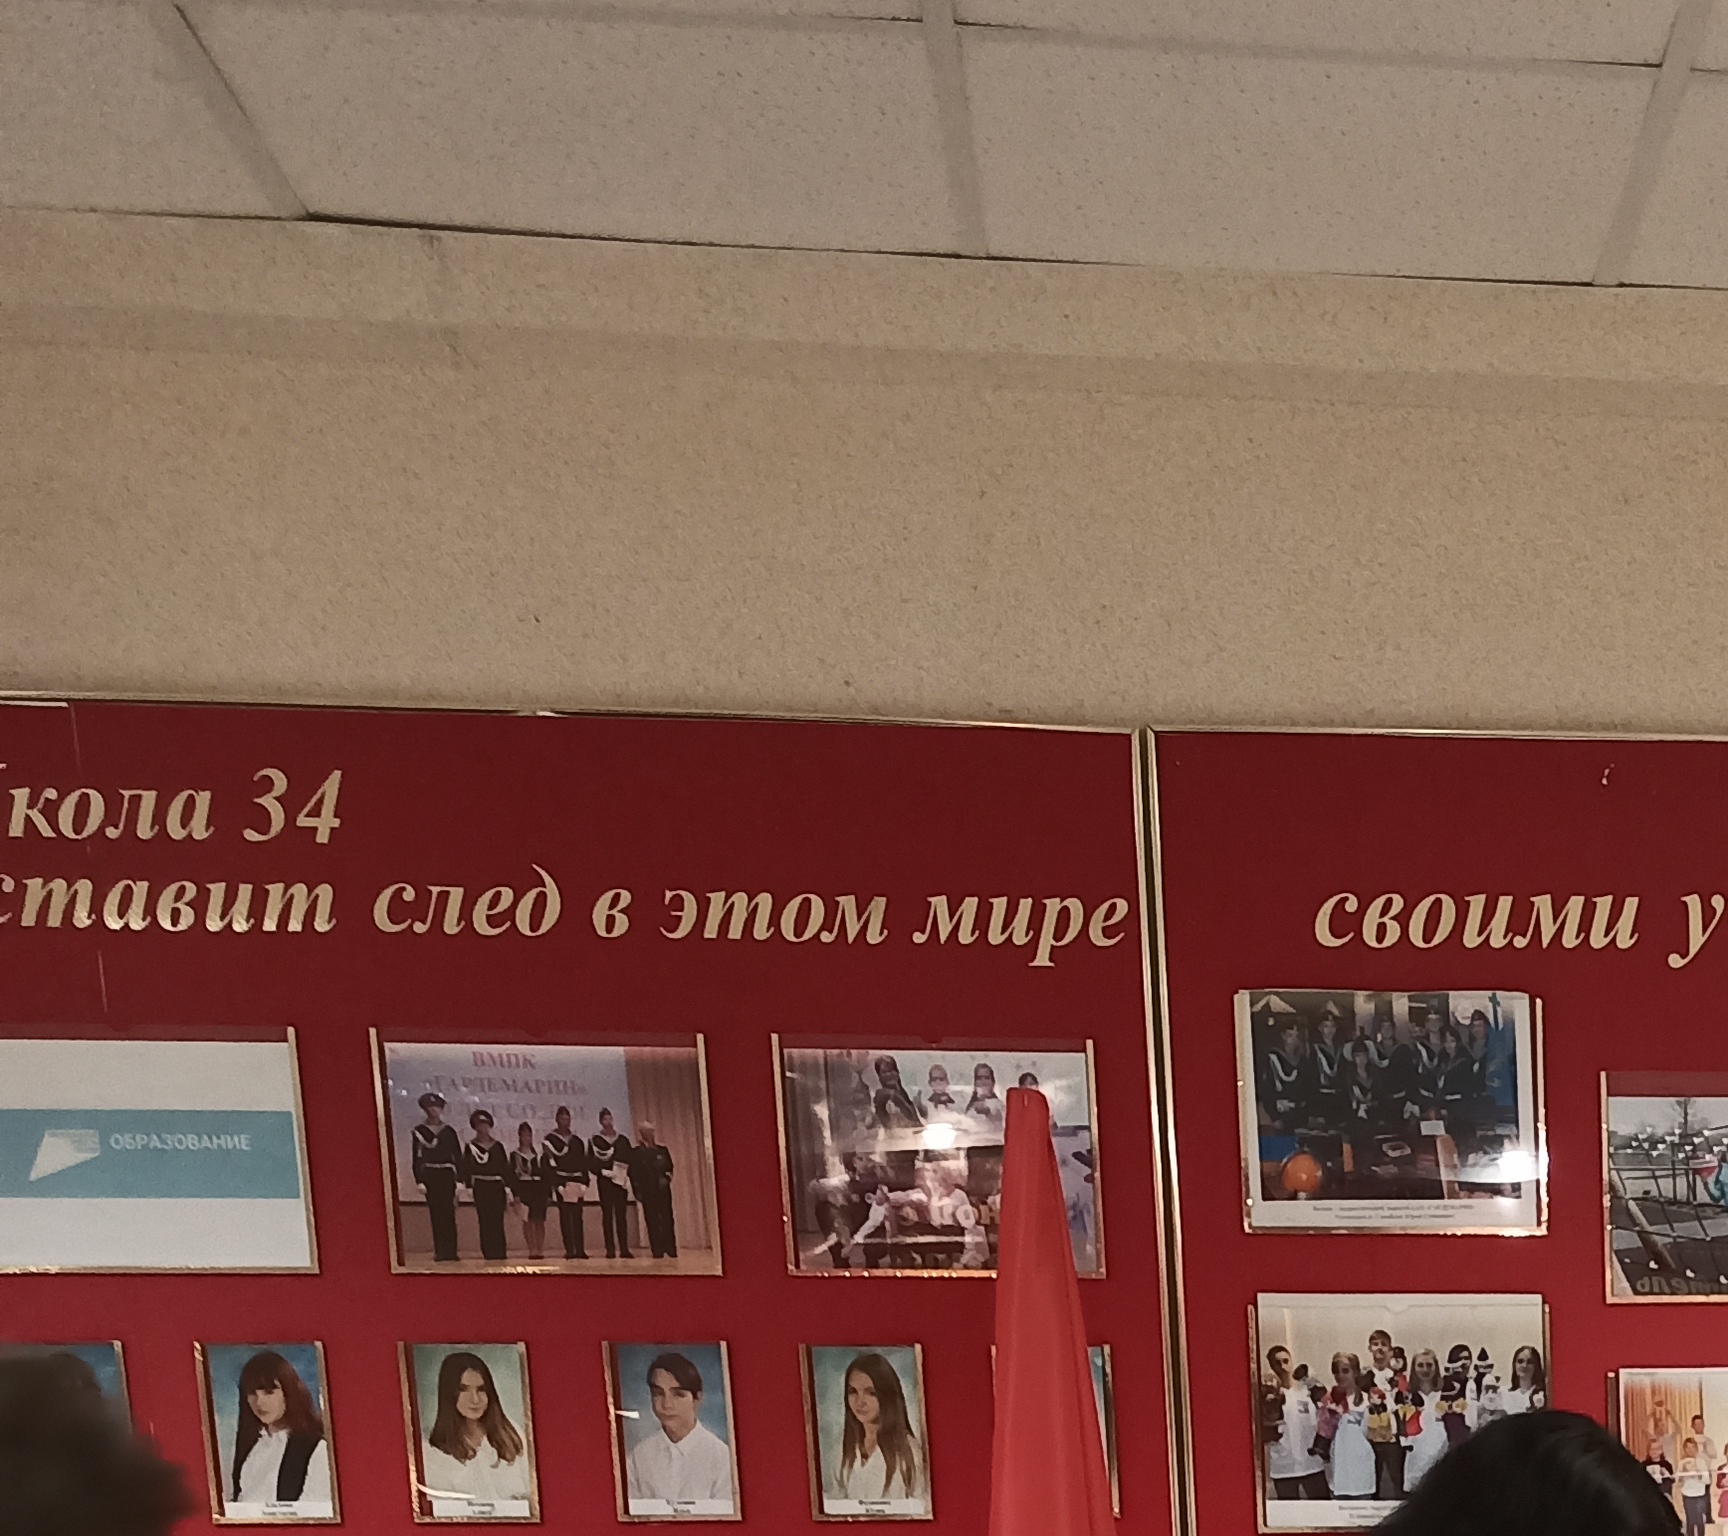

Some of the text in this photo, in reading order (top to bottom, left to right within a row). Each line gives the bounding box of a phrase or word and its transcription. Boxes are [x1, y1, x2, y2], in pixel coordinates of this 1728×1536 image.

[0, 762, 342, 844] кола 34
[373, 863, 561, 937] след
[591, 888, 632, 938] в
[659, 889, 888, 945] этом
[912, 894, 1129, 967] мире
[1314, 892, 1639, 950] своими
[109, 1132, 251, 1151] ОБРАЗОВАНИЕ
